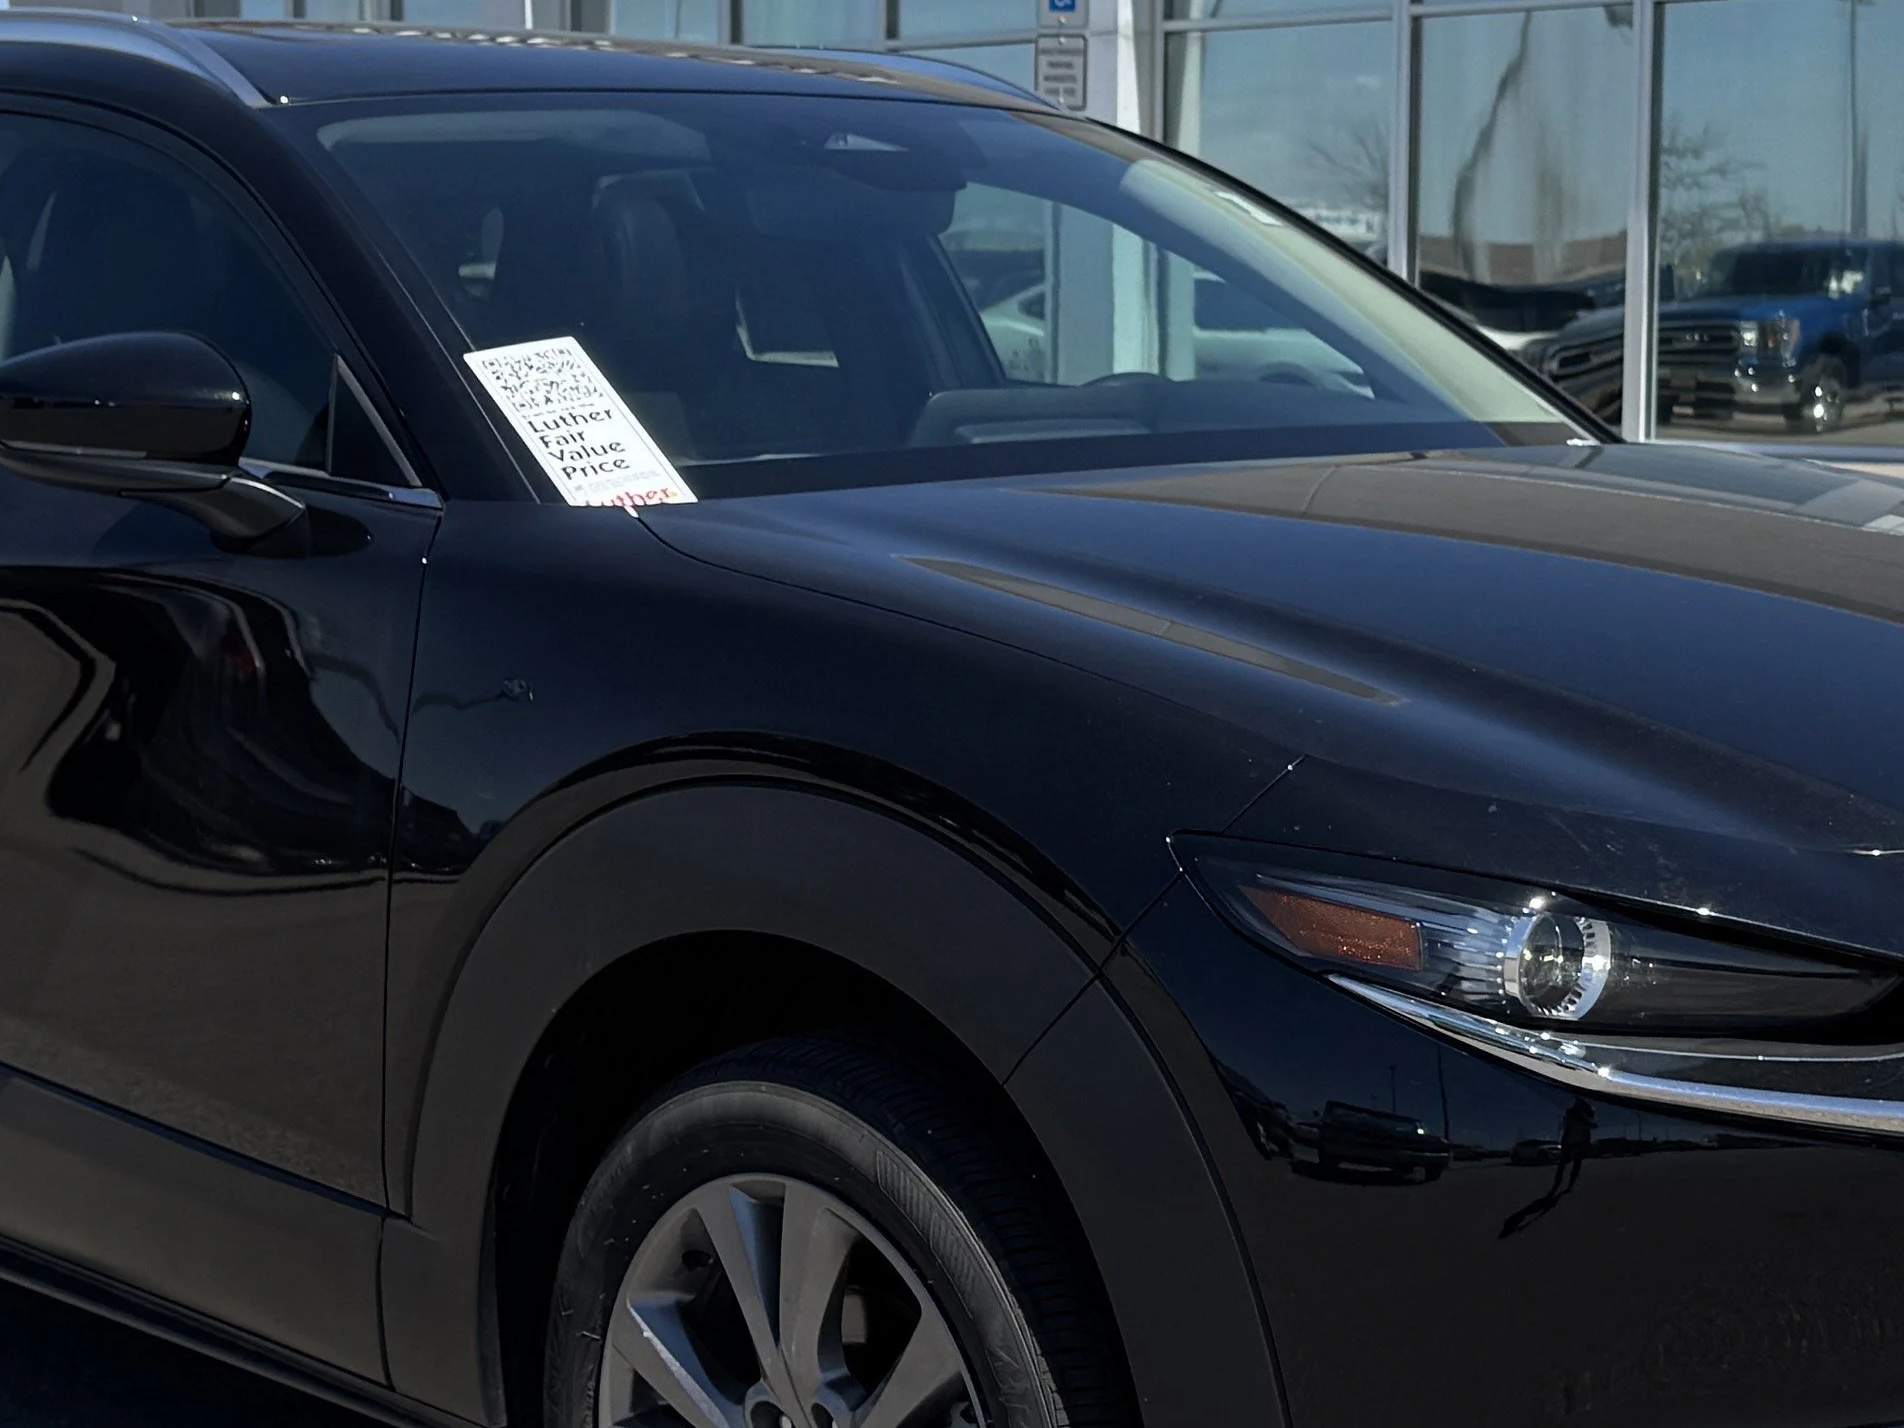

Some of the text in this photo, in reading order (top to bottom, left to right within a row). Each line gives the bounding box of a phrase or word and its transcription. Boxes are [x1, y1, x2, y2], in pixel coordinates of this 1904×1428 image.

[527, 409, 613, 433] Luther
[539, 430, 586, 448] Fair
[548, 441, 626, 462] Value
[561, 458, 631, 480] Price
[585, 487, 670, 507] ther
